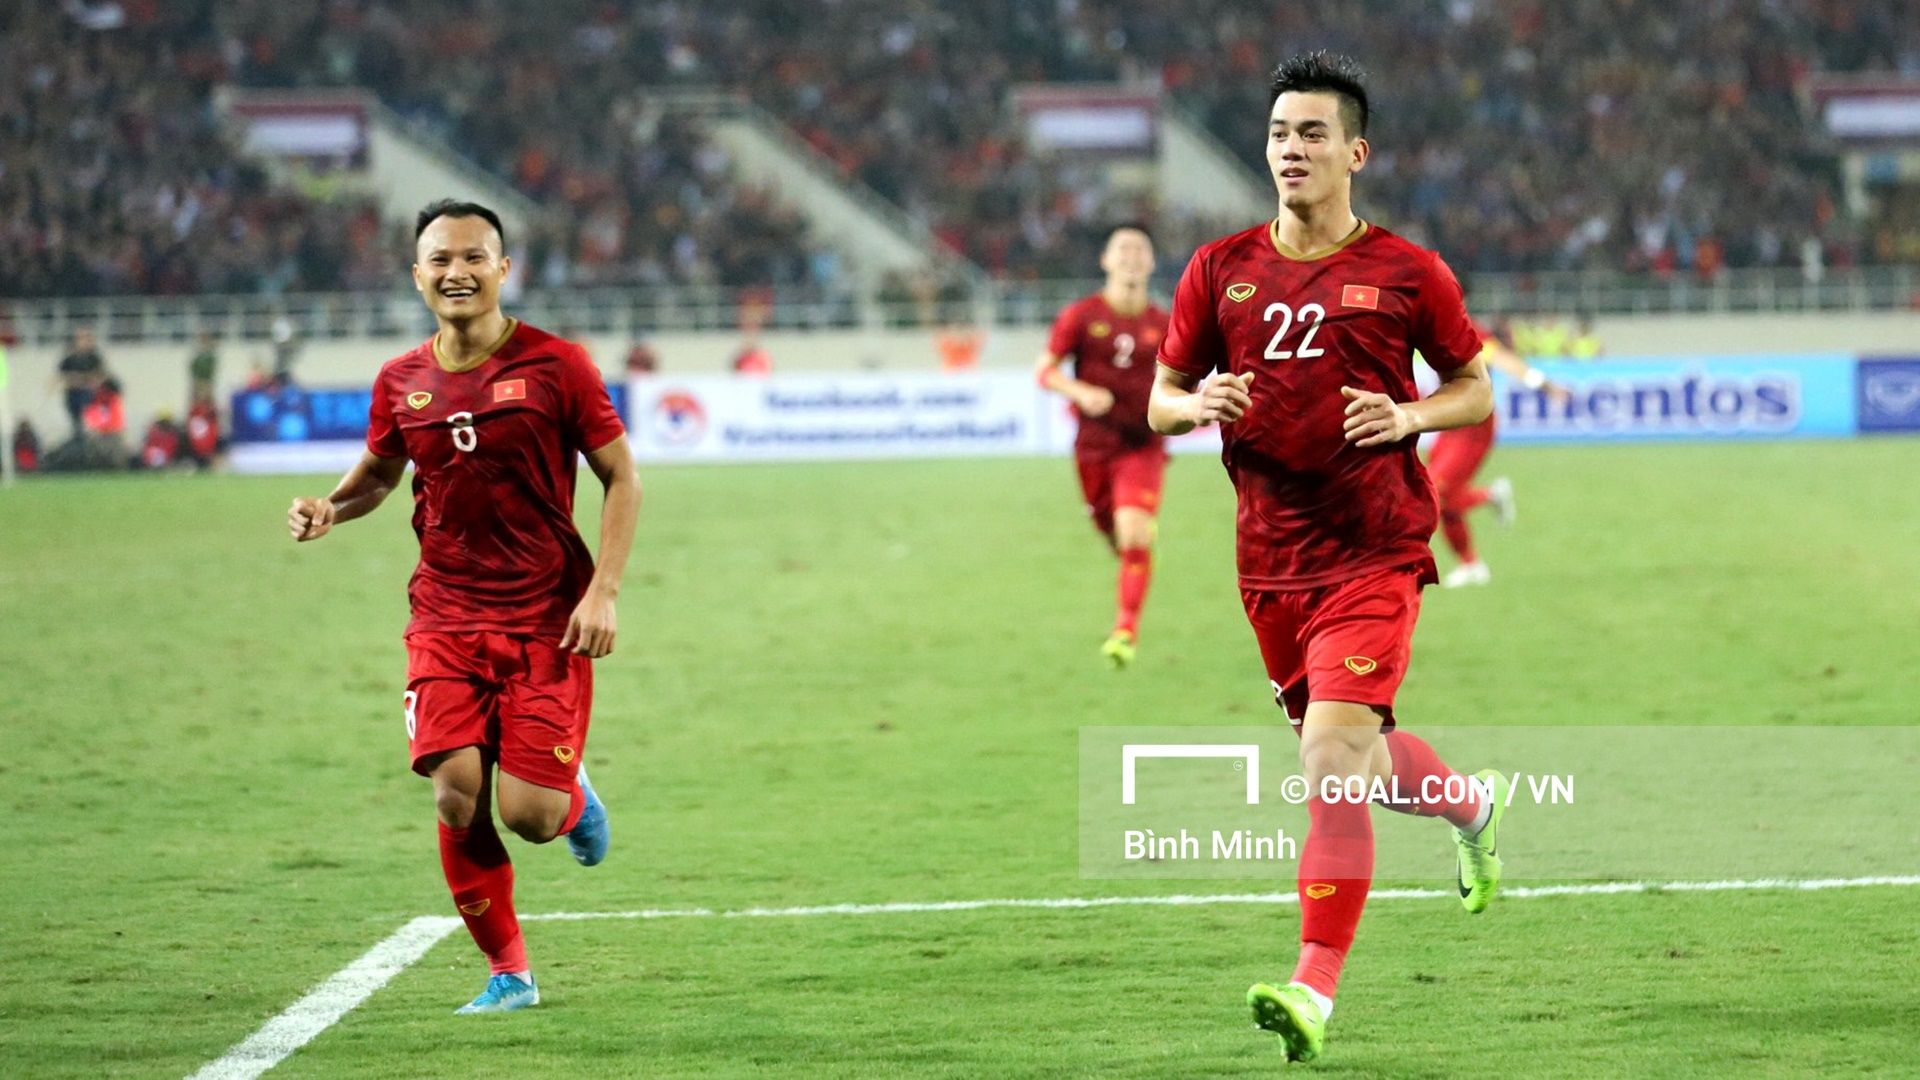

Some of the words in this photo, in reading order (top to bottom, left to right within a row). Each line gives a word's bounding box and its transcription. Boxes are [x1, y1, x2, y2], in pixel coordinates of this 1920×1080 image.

[1112, 332, 1136, 369] 2
[1263, 302, 1326, 359] 22
[1508, 377, 1790, 419] mentos
[446, 410, 477, 452] 8
[403, 690, 417, 740] 8
